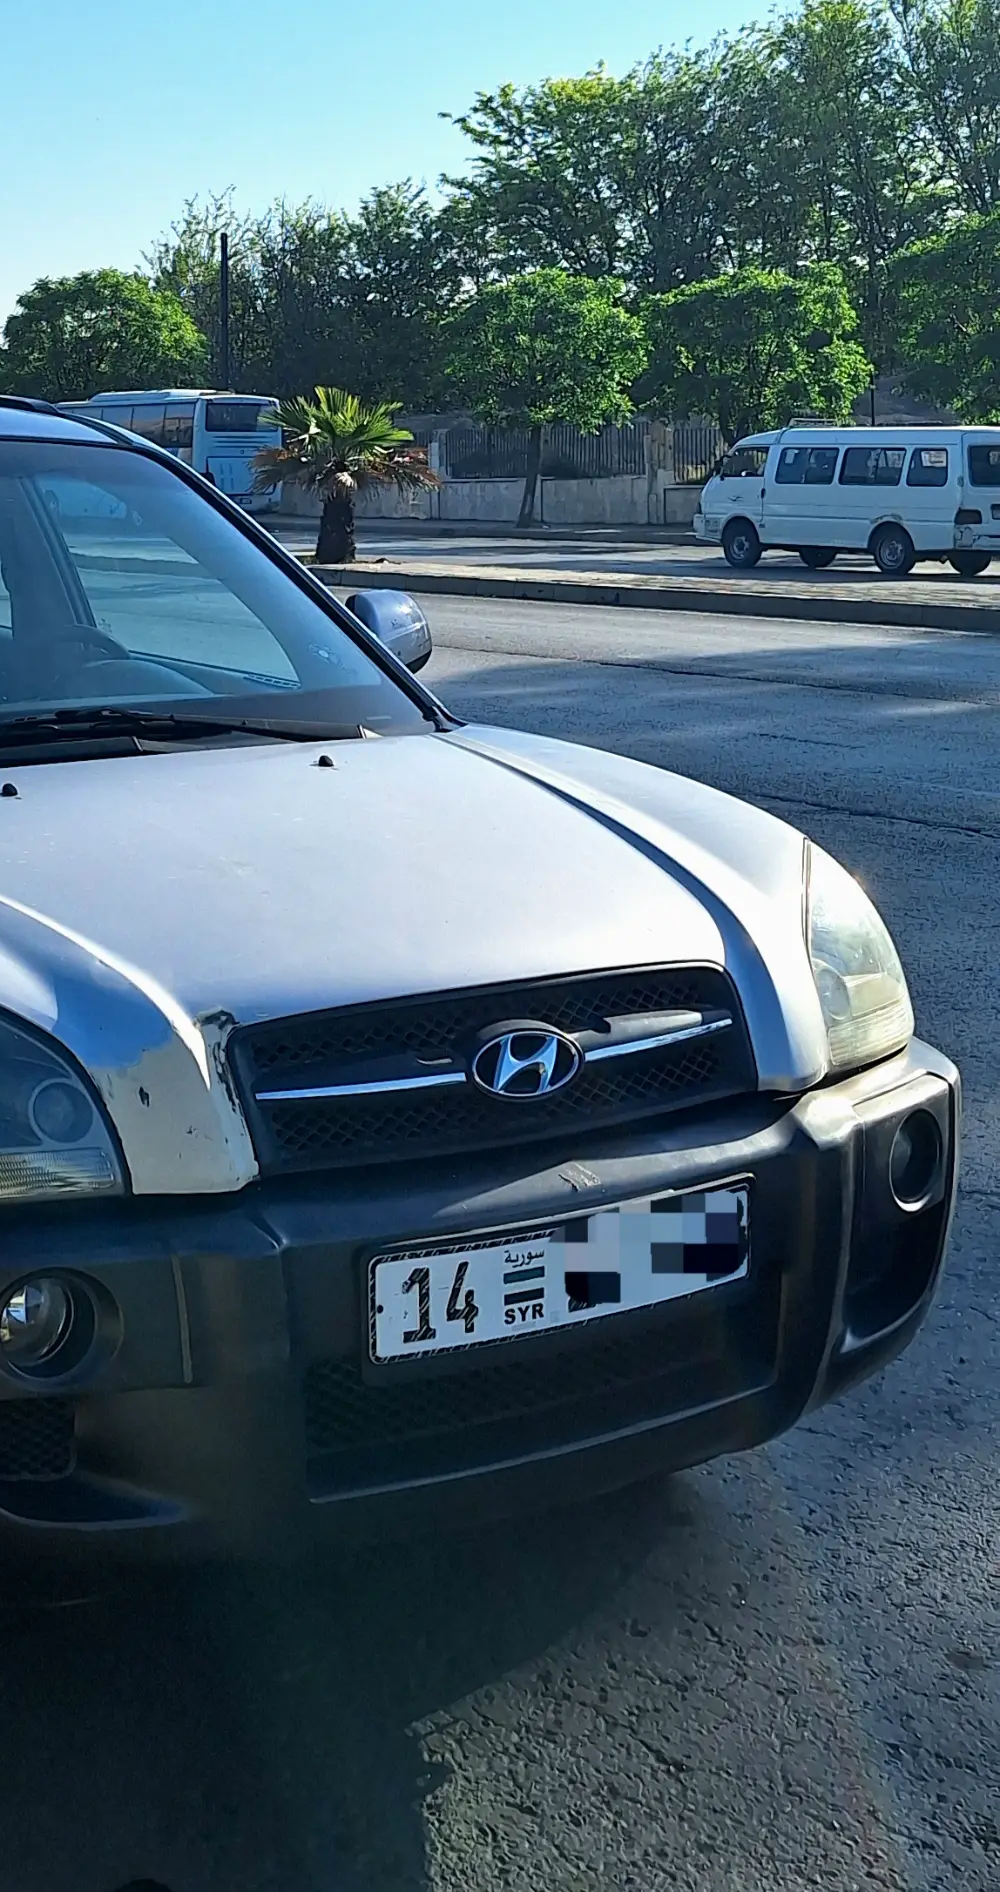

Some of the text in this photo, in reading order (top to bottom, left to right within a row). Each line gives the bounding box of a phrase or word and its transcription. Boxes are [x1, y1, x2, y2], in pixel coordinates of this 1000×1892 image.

[503, 1249, 545, 1268] سورية
[402, 1260, 479, 1344] 14
[503, 1302, 545, 1325] SYR
